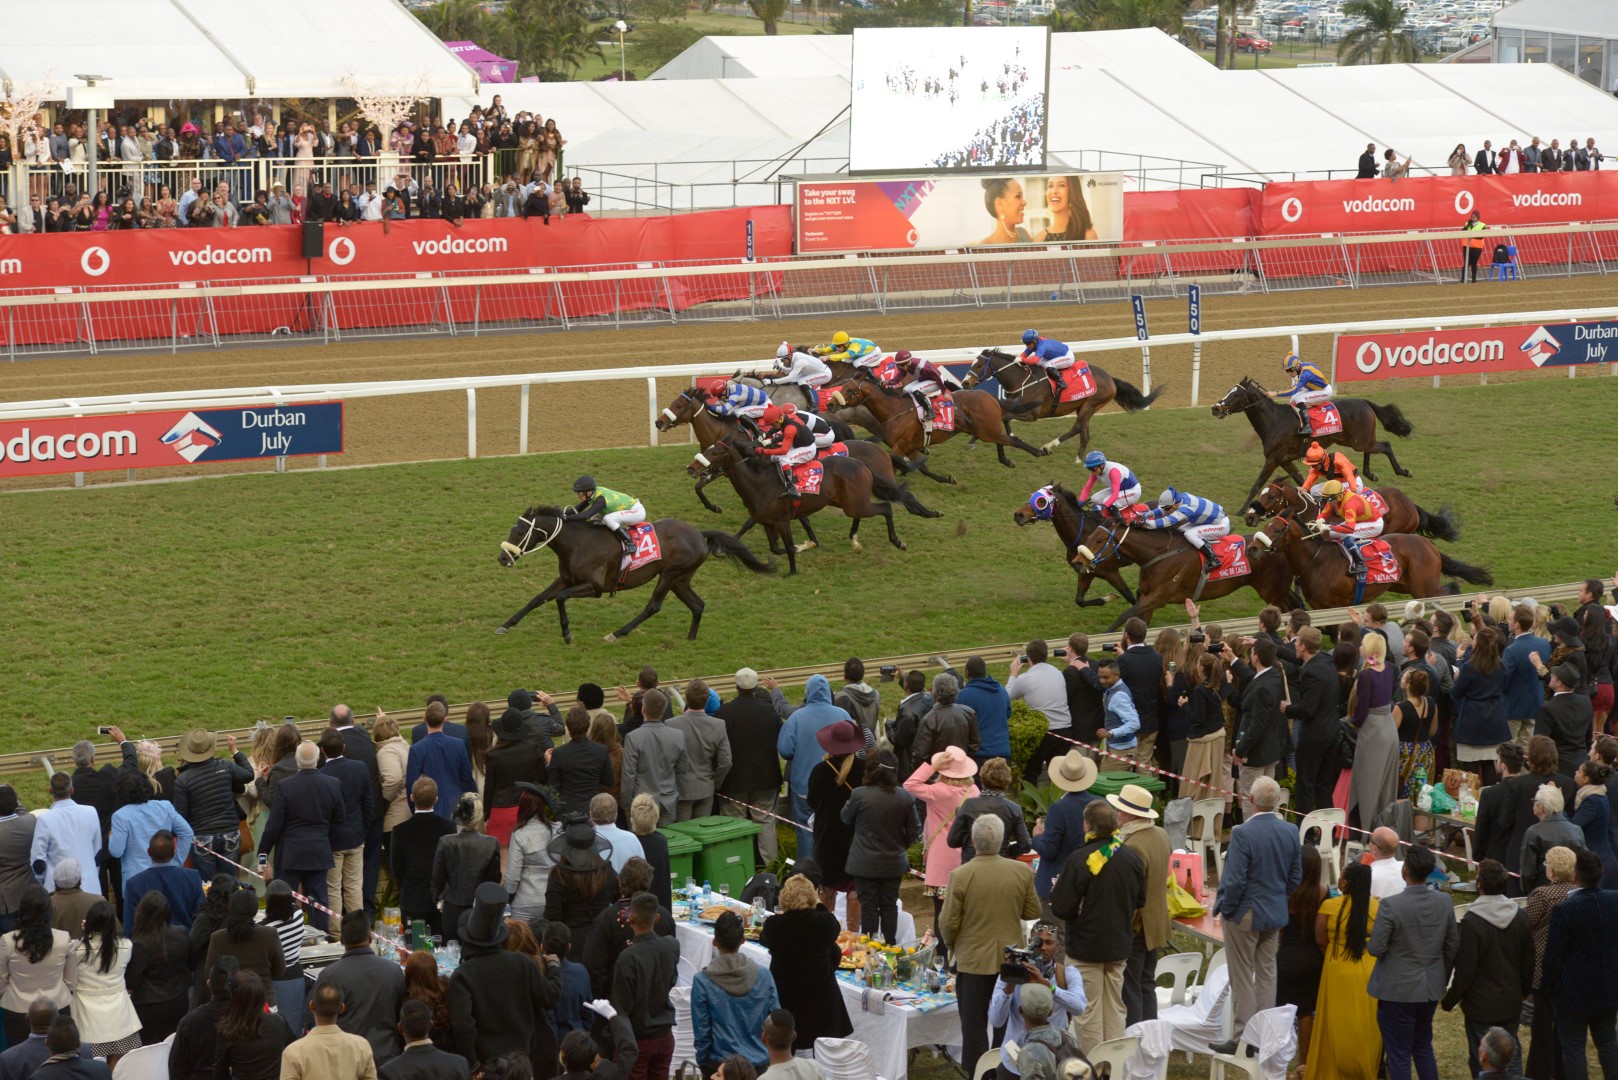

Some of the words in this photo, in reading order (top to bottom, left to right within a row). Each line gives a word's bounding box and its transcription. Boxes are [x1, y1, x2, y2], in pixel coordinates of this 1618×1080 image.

[804, 189, 821, 197] Take
[821, 190, 837, 198] your
[838, 189, 856, 197] swag
[812, 197, 825, 205] the
[842, 196, 856, 204] LVL
[1512, 189, 1582, 207] vodacom
[1342, 195, 1415, 213] vodacom
[413, 235, 508, 255] vodacom
[168, 244, 272, 266] vodacom
[1134, 299, 1146, 340] 150
[1190, 289, 1198, 331] 150
[1575, 324, 1618, 340] Durban
[1385, 337, 1504, 367] vodacom
[1584, 343, 1608, 362] July
[1081, 374, 1091, 390] 1
[242, 409, 306, 429] Durban
[1324, 411, 1339, 425] 4
[0, 428, 137, 463] dacom
[260, 431, 292, 455] July
[635, 534, 656, 558] 14
[1382, 557, 1398, 574] 5
